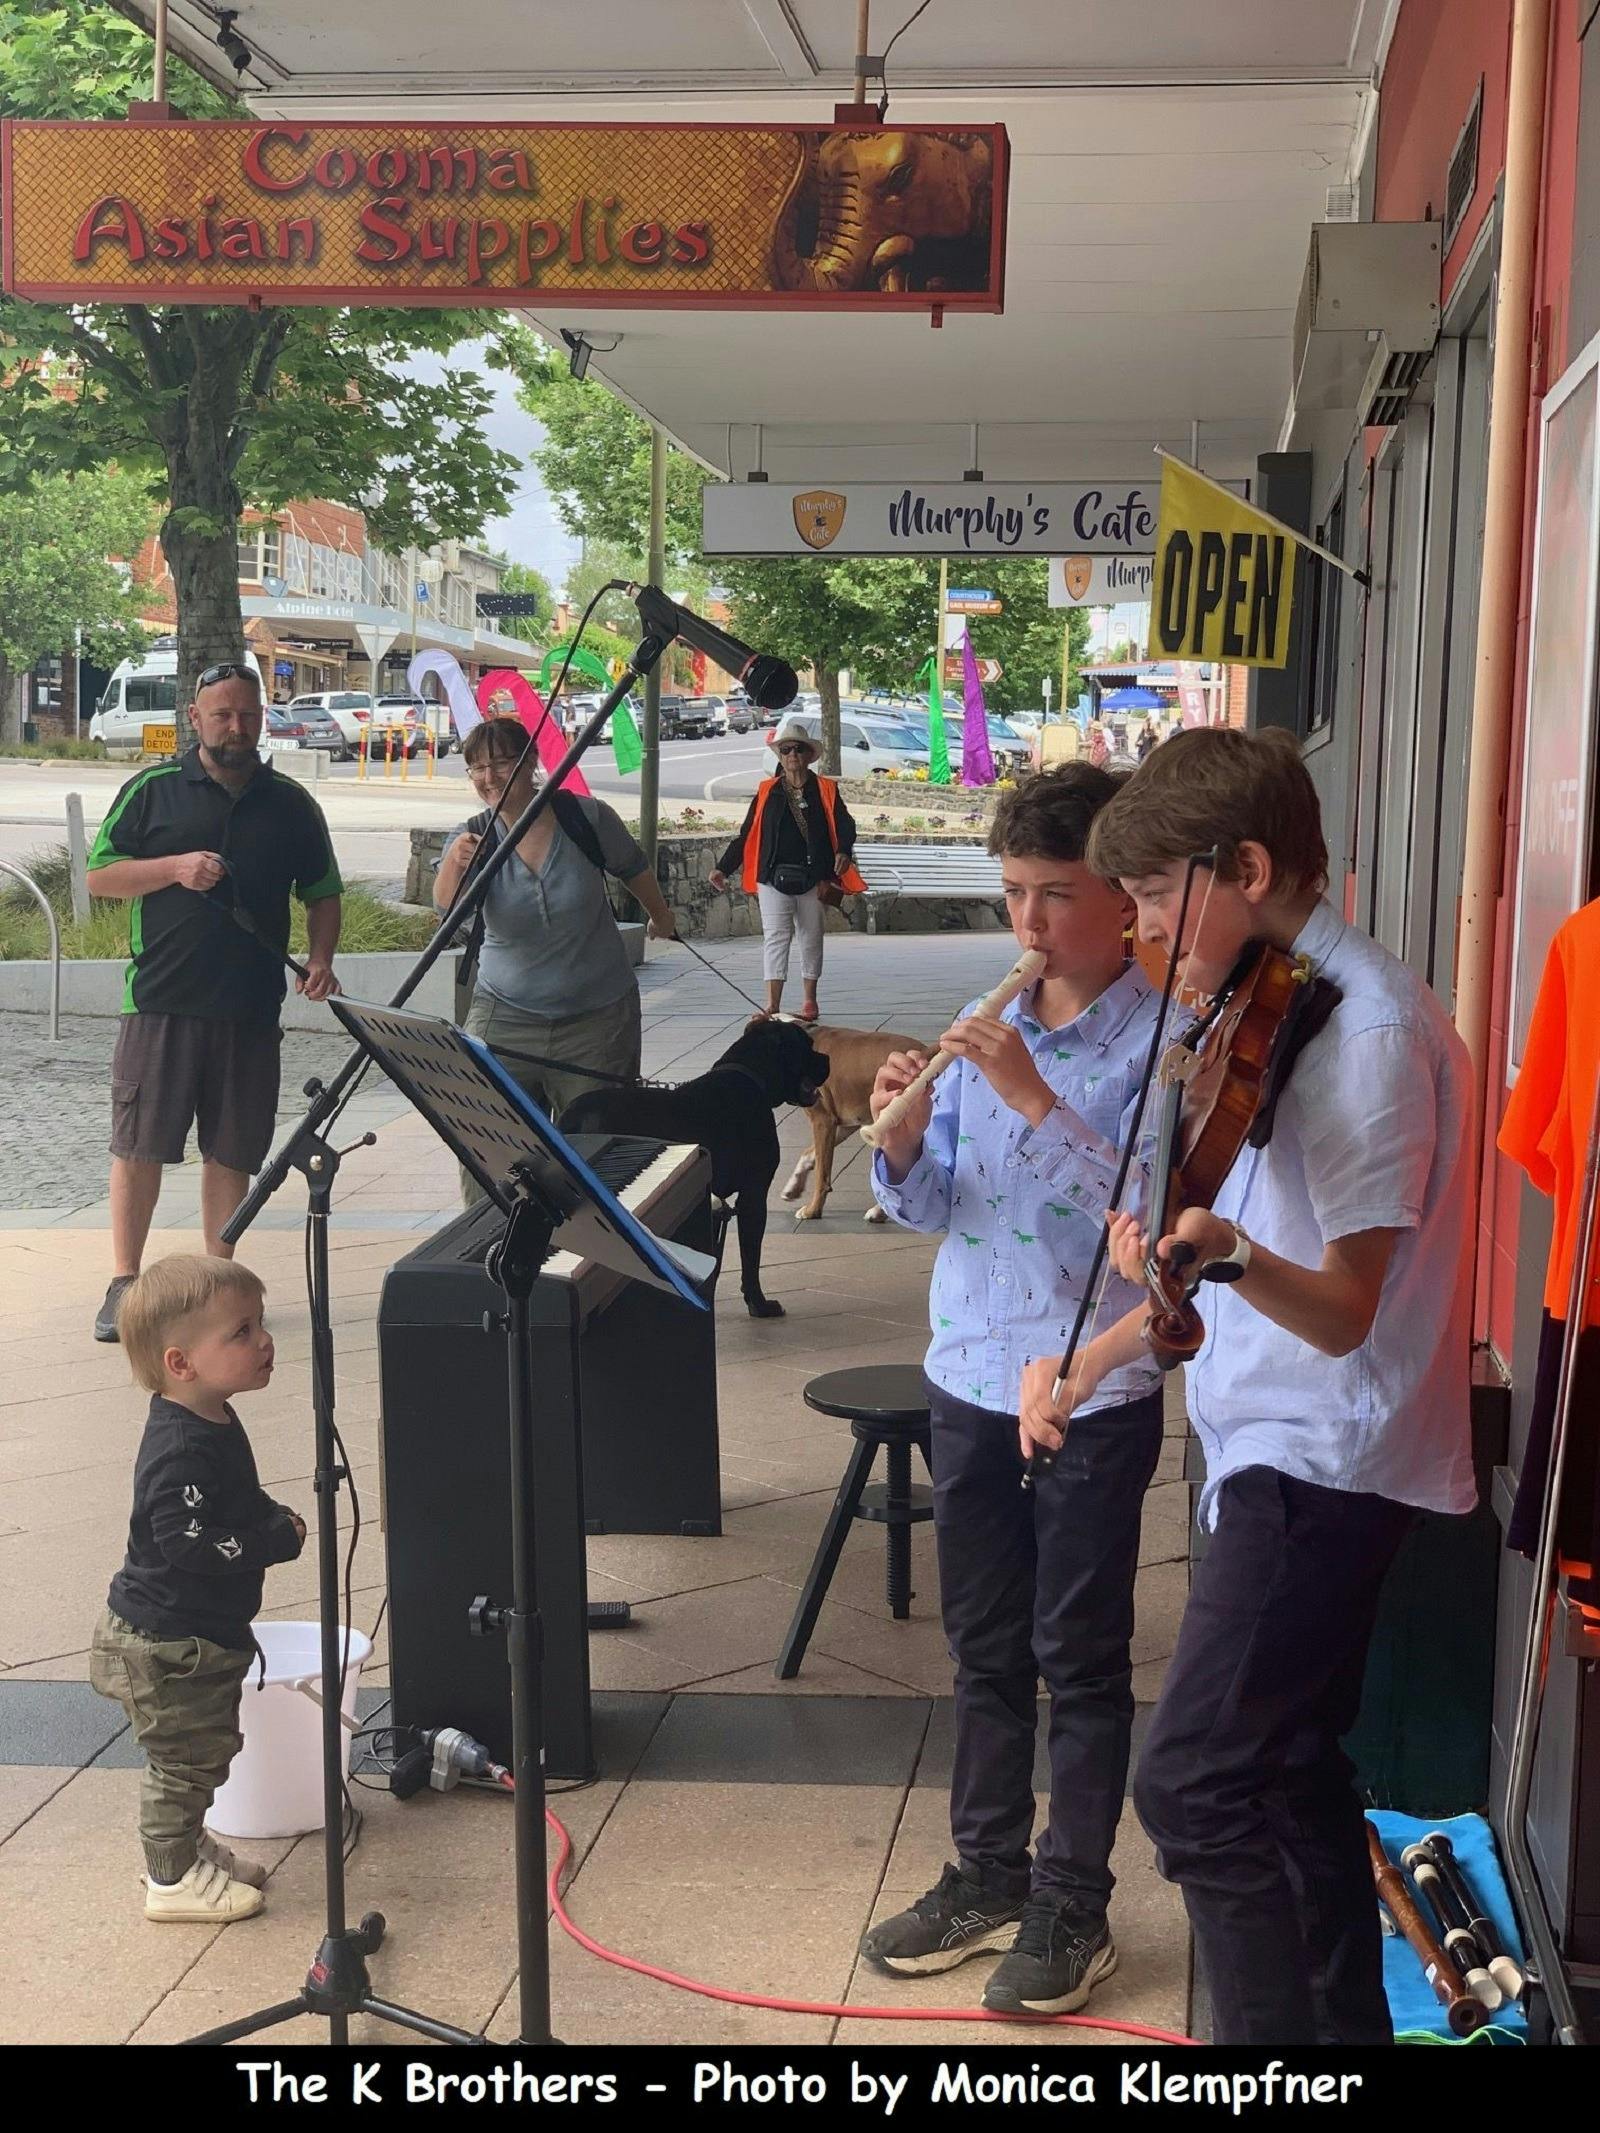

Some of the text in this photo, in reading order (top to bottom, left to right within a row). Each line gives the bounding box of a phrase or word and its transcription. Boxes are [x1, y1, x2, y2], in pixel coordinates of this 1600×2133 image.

[242, 127, 534, 192] Cooma
[72, 193, 711, 284] Asian Supplies
[889, 489, 1157, 548] Murphy's Cafe
[274, 602, 323, 616] Alpine
[1160, 530, 1285, 659] OPEN
[146, 739, 176, 749] DETOU
[155, 729, 175, 738] END
